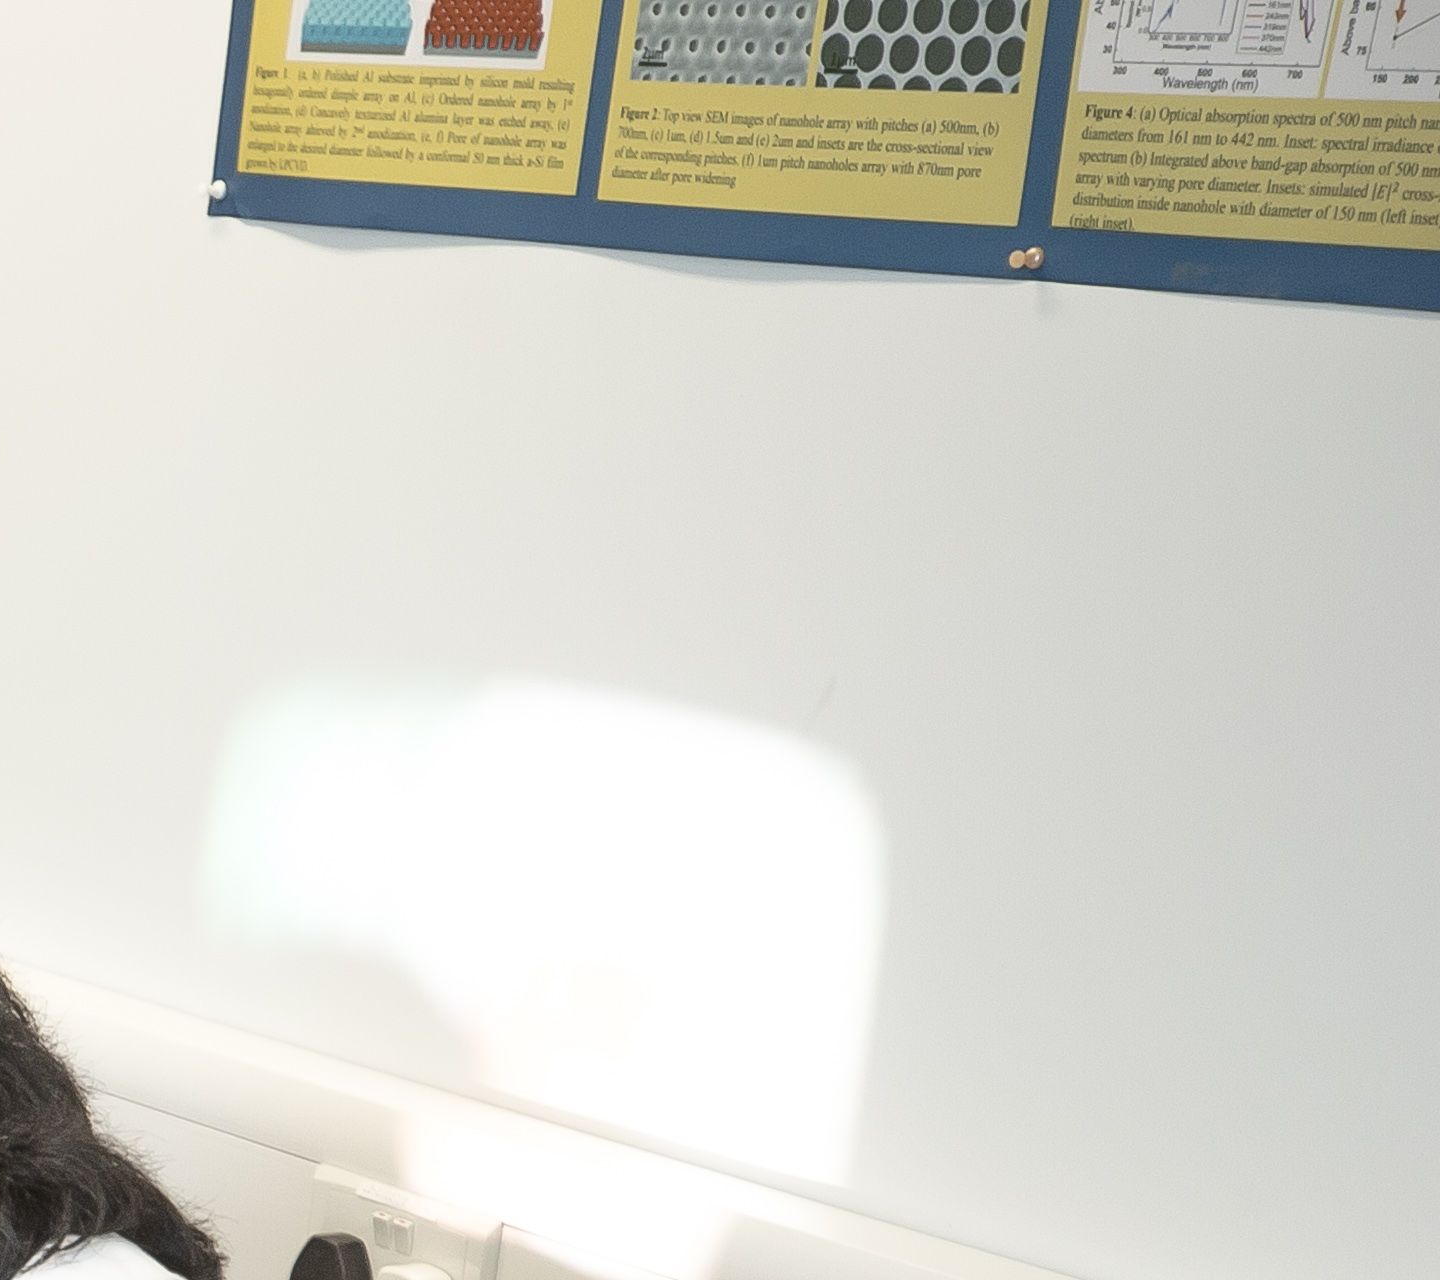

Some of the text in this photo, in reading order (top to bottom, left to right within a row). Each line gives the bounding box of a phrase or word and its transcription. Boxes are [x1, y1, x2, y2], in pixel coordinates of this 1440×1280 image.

[1341, 18, 1357, 55] Above
[1113, 66, 1303, 79] 300 400 500 600 700
[1162, 77, 1259, 93] Wavelength (nm)
[1372, 74, 1419, 84] 150 200
[620, 106, 650, 121] Figure
[663, 108, 680, 124] Top
[705, 111, 729, 124] SEM
[731, 111, 764, 128] images
[766, 112, 779, 126] of
[779, 114, 824, 128] nanohole
[826, 118, 853, 133] array
[856, 117, 878, 131] with
[881, 118, 918, 134] pitches
[921, 120, 937, 135] (a)
[939, 120, 980, 136] 500nm,
[982, 121, 1000, 138] (b)
[1085, 104, 1123, 121] Figure
[1139, 105, 1156, 123] (a)
[1159, 107, 1202, 125] Optical
[1206, 108, 1270, 128] absorption
[1273, 113, 1316, 128] spectra
[1320, 111, 1336, 126] of
[1337, 112, 1360, 127] 500
[1362, 117, 1382, 128] nm
[1384, 113, 1417, 132] pitch
[651, 128, 664, 142] (c)
[689, 130, 704, 144] (d)
[736, 133, 754, 146] and
[755, 134, 770, 148] (e)
[796, 135, 814, 149] and
[817, 136, 845, 151] insets
[848, 141, 864, 151] are
[867, 139, 883, 152] the
[885, 140, 964, 156] cross-sectional
[967, 142, 994, 156] view
[1081, 126, 1435, 153] diameters from 161 nm to 442 nm. Inset: spectral irradiance
[640, 149, 702, 166] corresponding
[741, 152, 755, 168] (f)
[780, 154, 804, 171] pitch
[807, 156, 859, 172] nanoholes
[861, 162, 886, 177] array
[891, 160, 914, 175] with
[916, 162, 954, 177] 870nm
[956, 167, 982, 180] pore
[1078, 151, 1440, 178] spectrum (b) Integrated above band-gap absorption of 500 nm
[649, 168, 669, 181] after
[671, 173, 692, 185] pore
[694, 171, 737, 189] widening
[1075, 172, 1103, 188] array
[1106, 171, 1130, 186] with
[1133, 174, 1176, 191] varying
[1178, 179, 1204, 193] pore
[1208, 176, 1262, 193] diameter.
[1266, 179, 1305, 195] Insets:
[1309, 181, 1369, 198] simulated
[1069, 214, 1099, 230] (right
[1072, 192, 1134, 209] distribution
[1137, 195, 1170, 211] inside
[1172, 199, 1226, 214] nanohole
[1230, 201, 1256, 216] with
[1259, 202, 1313, 219] diameter
[1315, 205, 1332, 220] of
[1333, 206, 1356, 221] 150
[1357, 211, 1377, 222] nm
[1381, 208, 1407, 226] (left
